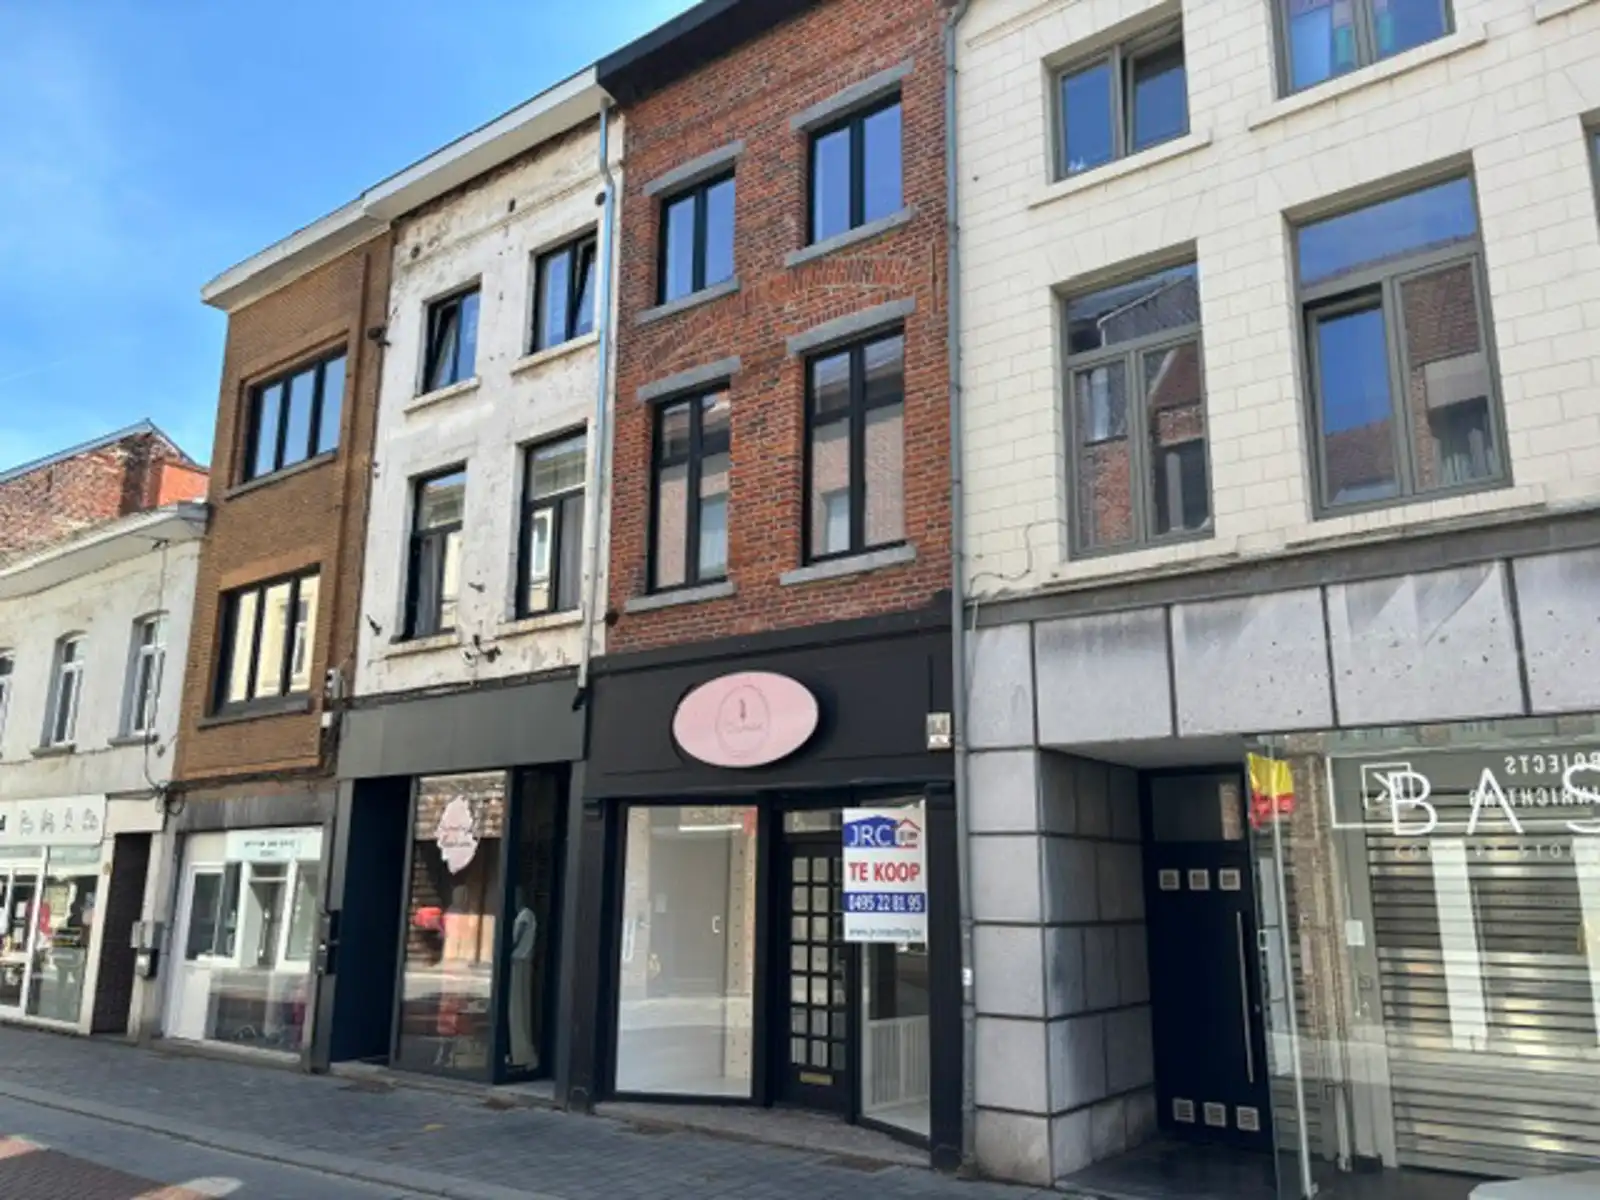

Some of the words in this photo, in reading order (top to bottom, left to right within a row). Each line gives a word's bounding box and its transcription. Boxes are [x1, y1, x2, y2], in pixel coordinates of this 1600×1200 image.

[850, 824, 891, 847] JRC
[848, 862, 868, 881] TE
[874, 862, 921, 882] KOOP
[849, 894, 875, 911] 0495
[877, 894, 890, 911] 22
[908, 894, 922, 911] 95
